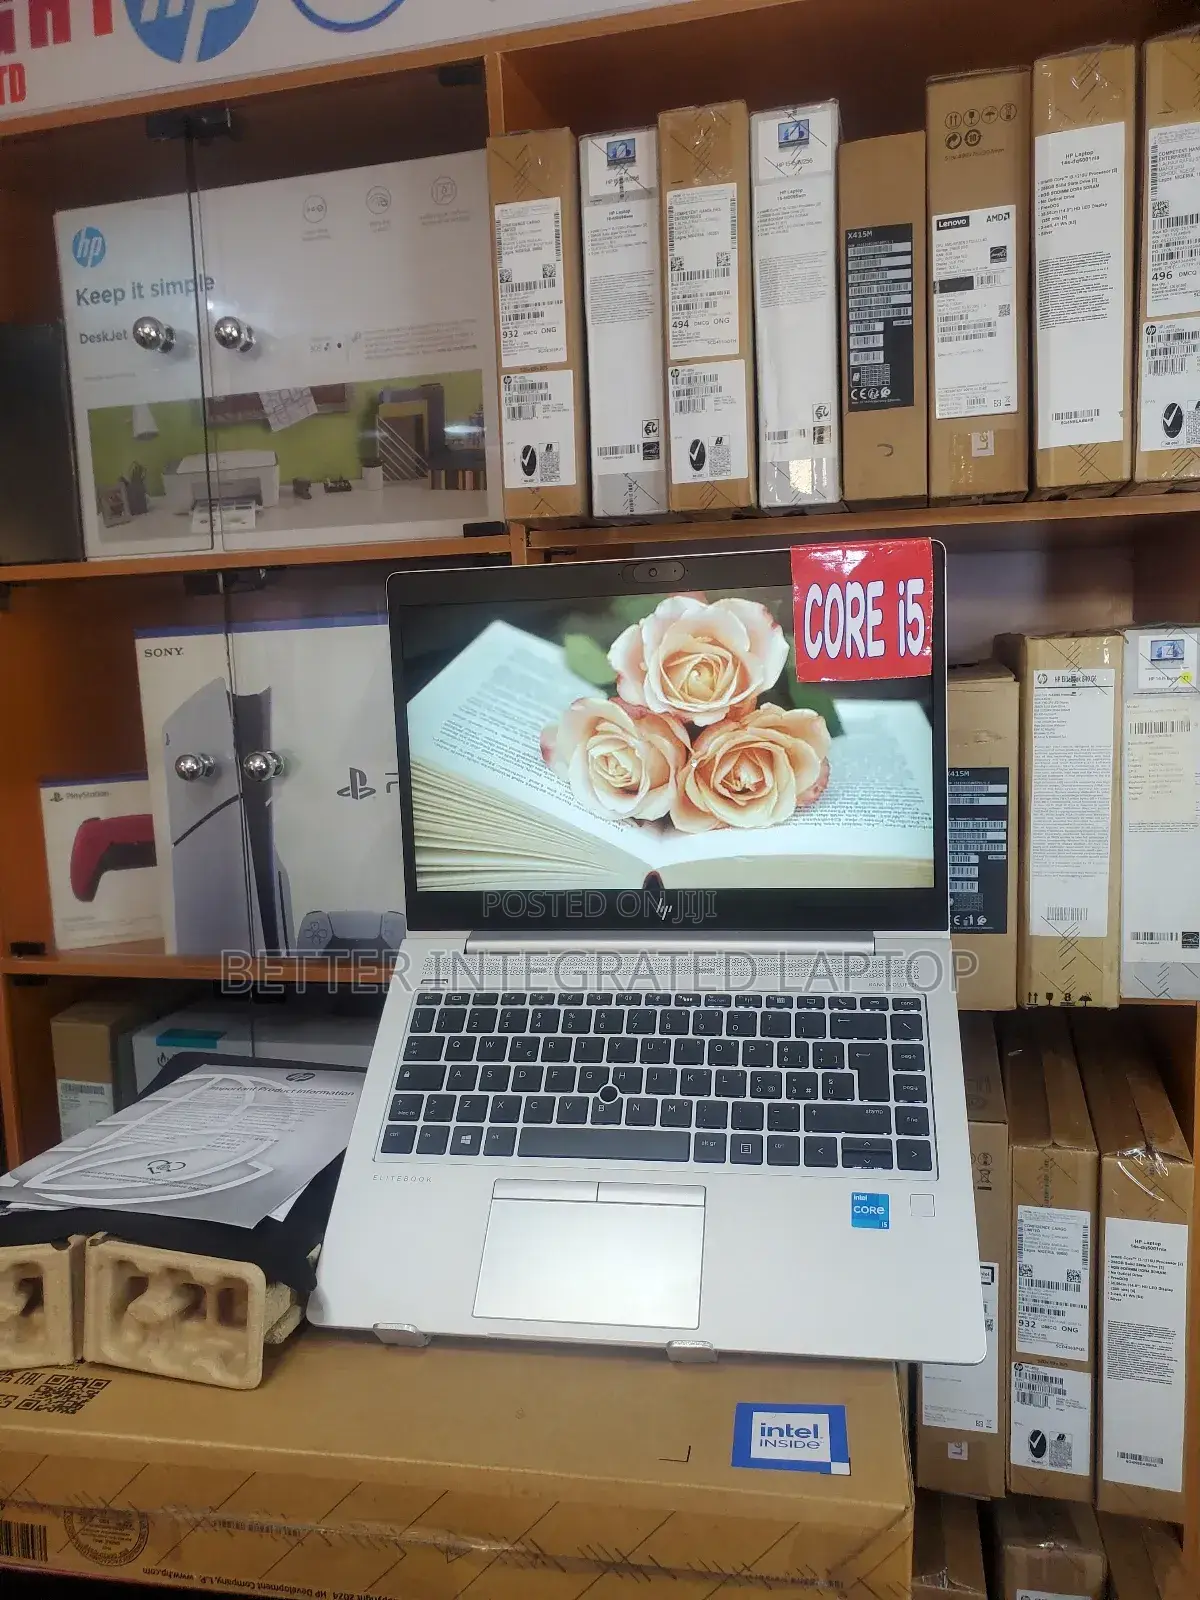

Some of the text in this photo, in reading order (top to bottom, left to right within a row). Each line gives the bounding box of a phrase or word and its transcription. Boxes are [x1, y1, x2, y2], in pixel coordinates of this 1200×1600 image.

[1075, 150, 1094, 158] Laptop
[938, 218, 967, 228] Lenovo
[986, 213, 1004, 223] AMD
[848, 230, 873, 240] X415M
[75, 227, 104, 267] hp
[1152, 270, 1173, 281] 496
[76, 274, 215, 306] Keep it simple
[672, 317, 730, 328] 494 ONG
[79, 329, 128, 345] DeskJet
[502, 326, 557, 339] 932 ONG
[802, 577, 926, 660] CORE i5
[144, 647, 184, 658] SONY
[66, 790, 110, 801] PlayStation
[258, 1085, 298, 1094] Product
[298, 1088, 355, 1097] Information
[372, 1174, 433, 1183] ELITEBOOK
[1018, 1319, 1079, 1333] 932 ONG
[760, 1422, 820, 1438] intel
[142, 1567, 194, 1581] www.hp.com
[215, 1576, 255, 1590] Company,
[257, 1581, 313, 1596] Development
[314, 1588, 327, 1597] HP
